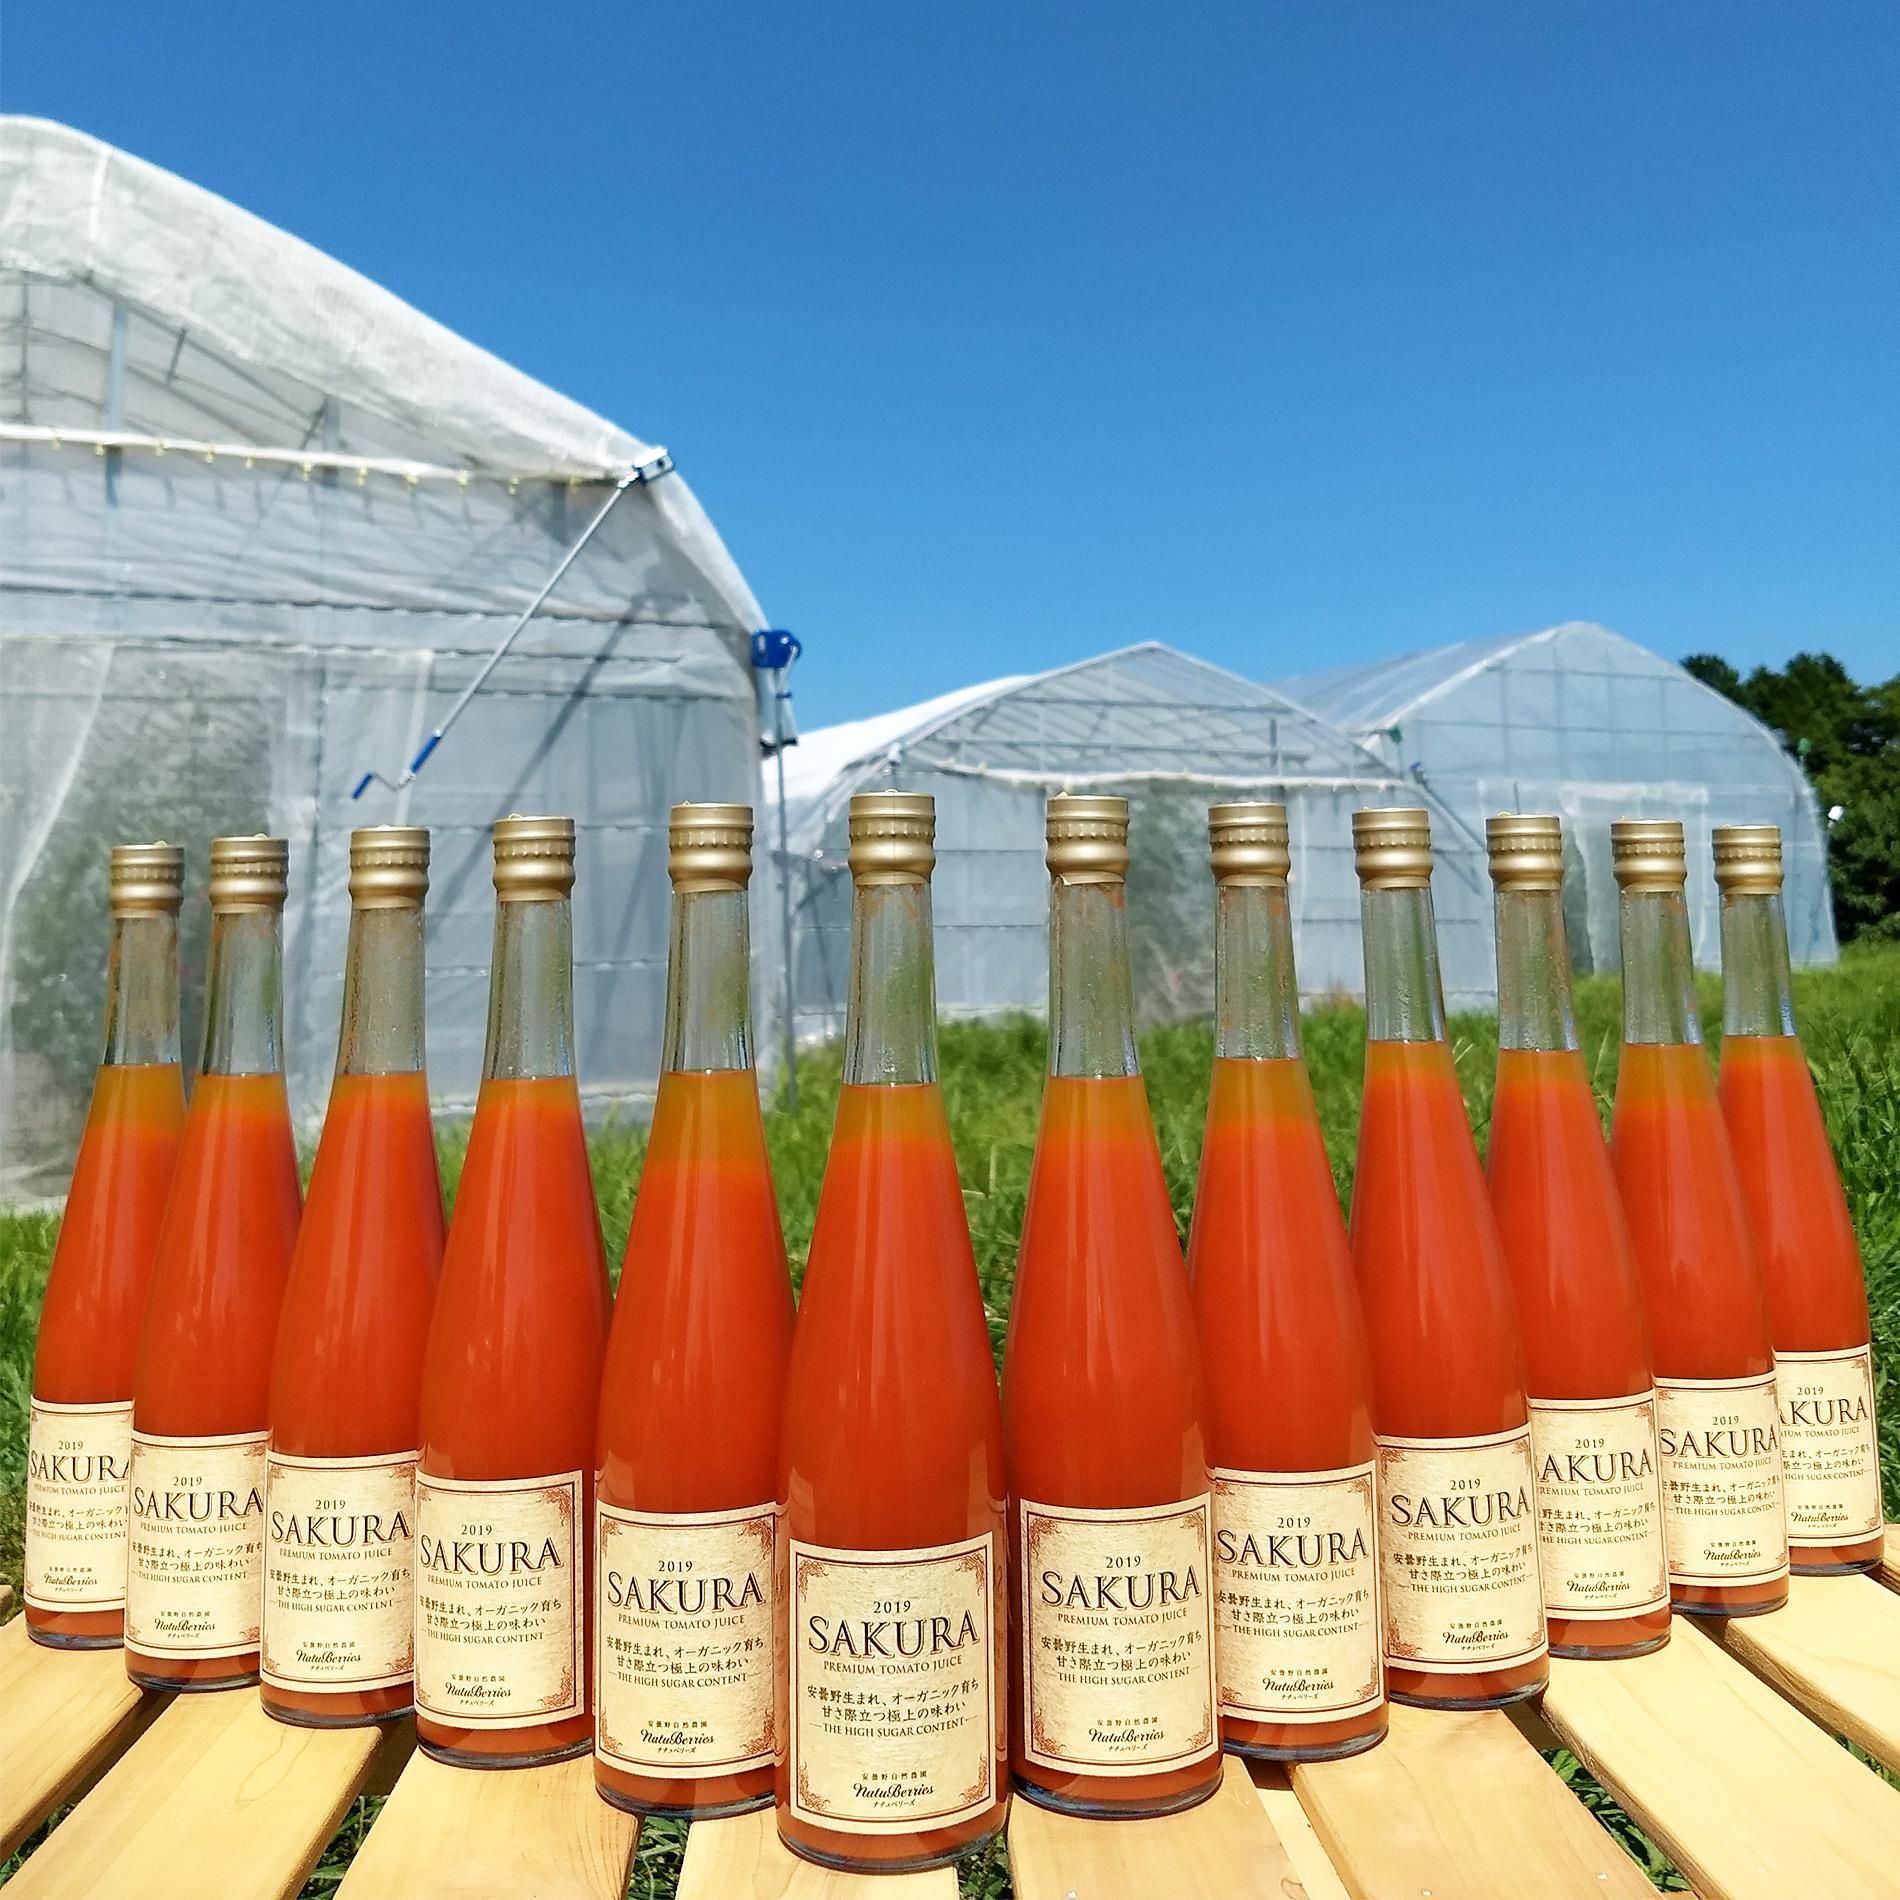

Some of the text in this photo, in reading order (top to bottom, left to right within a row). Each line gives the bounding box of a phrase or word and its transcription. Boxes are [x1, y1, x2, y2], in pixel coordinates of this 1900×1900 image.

[1797, 1386, 1824, 1396] 2019
[1712, 1416, 1739, 1425] 2019
[1805, 1429, 1839, 1437] TOMATO
[1842, 1426, 1860, 1436] JUICE
[59, 1441, 84, 1450] 2019
[1575, 1438, 1604, 1449] 2019
[1660, 1424, 1779, 1459] SAKURA
[1536, 1448, 1654, 1484] AKURA
[1673, 1456, 1772, 1470] PREMIUM TOMATO JUICE
[173, 1476, 203, 1487] 2019
[1806, 1472, 1832, 1481] SUGAR
[1833, 1469, 1865, 1480] CONTENT
[61, 1487, 97, 1495] TOMATO
[99, 1485, 125, 1495] JUICE
[1450, 1478, 1481, 1490] 2019
[1539, 1482, 1644, 1496] REMIUM TOMATO JUICE
[134, 1487, 263, 1521] SAKURA
[315, 1500, 346, 1510] 2019
[1391, 1486, 1531, 1529] SAKURA
[1694, 1508, 1718, 1516] HIGH
[1720, 1507, 1747, 1516] SUGAR
[1748, 1501, 1775, 1514] CONTENT
[140, 1522, 248, 1534] PREMIUM TOMATO JUICE
[271, 1510, 413, 1548] SAKURA
[461, 1524, 493, 1536] 2019
[1277, 1517, 1310, 1529] 2019
[59, 1532, 83, 1541] SUGAR
[1408, 1523, 1521, 1541] PREMIUM TOMATO JUICE
[1556, 1536, 1582, 1545] HIGH
[1584, 1536, 1612, 1545] SUGAR
[1614, 1531, 1648, 1543] CONTENT
[279, 1548, 392, 1560] PREMIUM TOMATO JUICE
[1217, 1527, 1369, 1568] SAKURA
[420, 1535, 564, 1576] SAKURA
[1106, 1556, 1141, 1568] 2019
[658, 1560, 693, 1572] 2019
[138, 1571, 248, 1583] THE HIGH SUGAR CONTENT
[428, 1575, 543, 1589] PREMIUM TOMATO JUICE
[1232, 1568, 1355, 1582] PREMIUM TOMATO JUICE
[1041, 1564, 1202, 1611] SAKURA
[1411, 1576, 1526, 1593] THE HIGH SUGAR CONTENT
[608, 1571, 766, 1615] SAKURA
[278, 1600, 392, 1612] THE HIGH SUGAR CONTENT
[873, 1600, 911, 1614] 2019
[618, 1614, 745, 1629] PREMIUM TOMATO JUICE
[1058, 1608, 1188, 1626] PREMIUM TOMATO JUICE
[428, 1630, 544, 1644] THE HIGH SUGAR CONTENT
[809, 1609, 981, 1659] SAKURA
[1233, 1622, 1358, 1638] THE HIGH SUGAR CONTENT
[824, 1655, 962, 1675] PREMIUM TOMATO JUICE
[618, 1672, 748, 1688] THE HIGH SUGAR CONTENT
[1057, 1666, 1191, 1685] THE HIGH SUGAR CONTENT
[824, 1718, 965, 1738] THE HIGH SUGAR CONTENT
